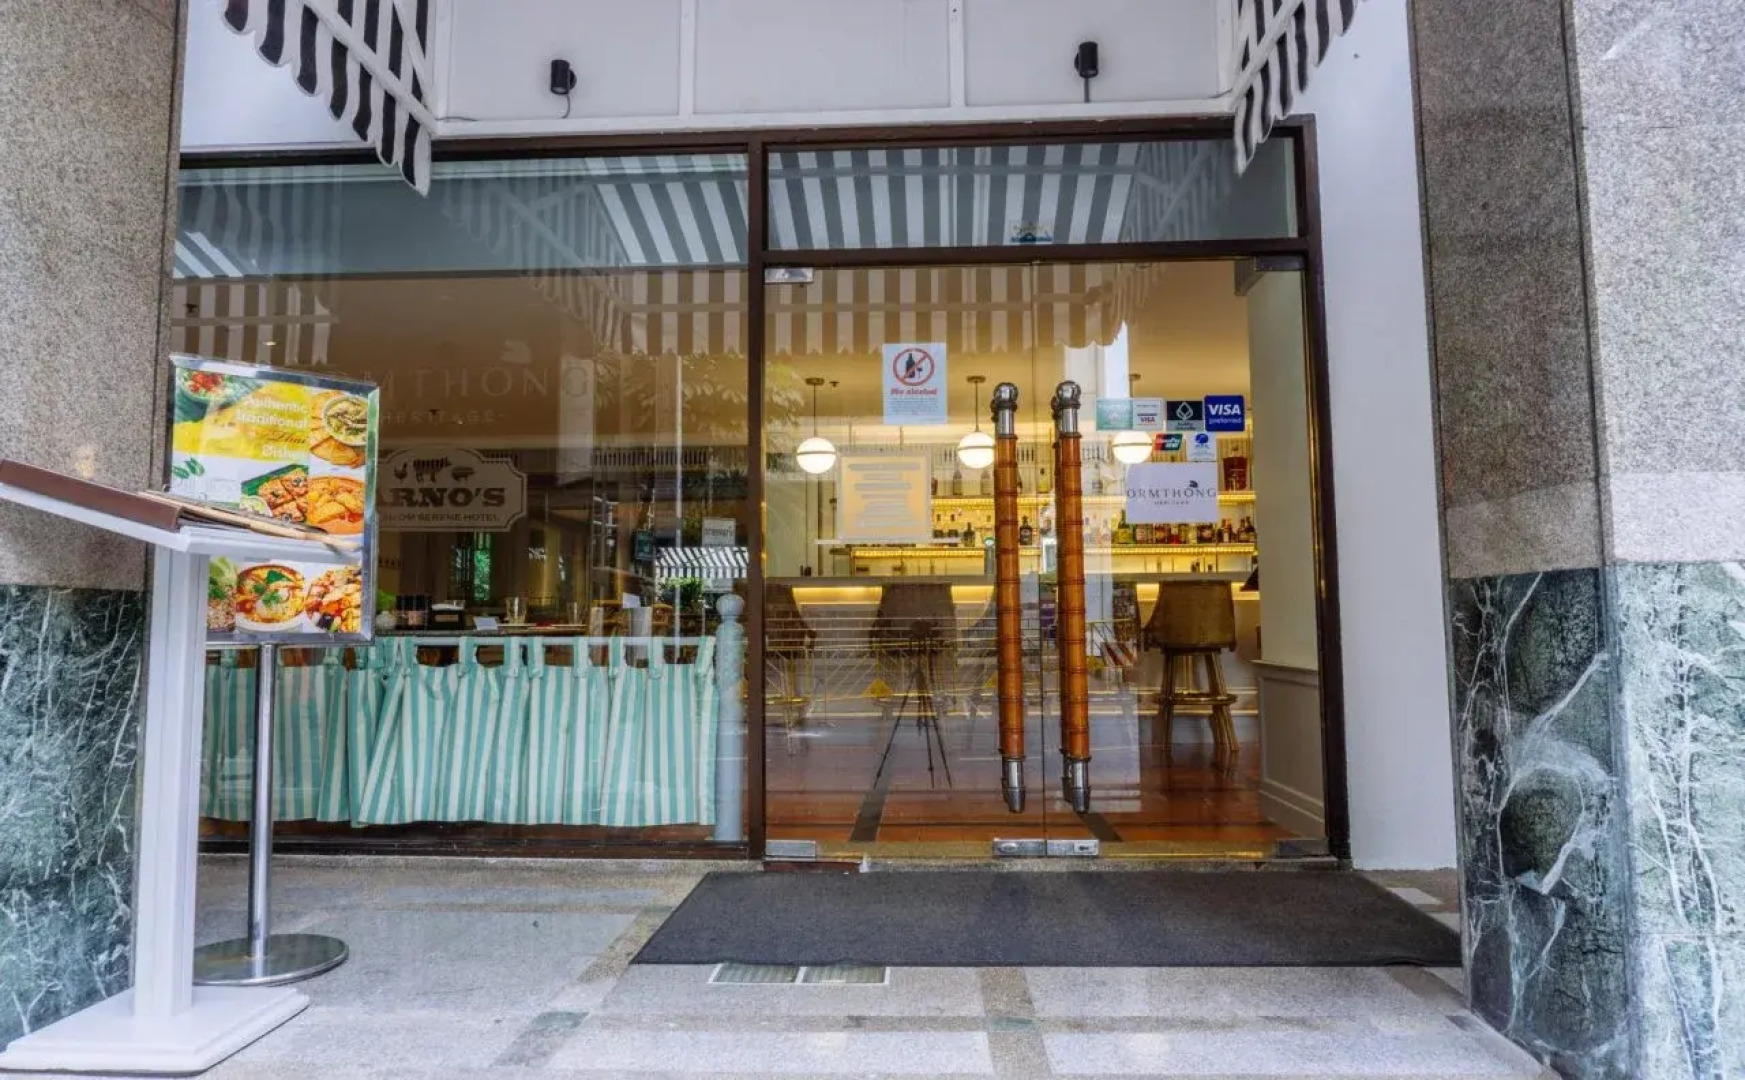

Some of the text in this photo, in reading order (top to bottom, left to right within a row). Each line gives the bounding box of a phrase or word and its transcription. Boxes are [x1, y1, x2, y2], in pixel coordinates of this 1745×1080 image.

[905, 387, 938, 395] alcohol
[1208, 404, 1241, 415] VISA
[1208, 416, 1242, 425] preferred
[1126, 487, 1217, 499] ORMTHONG
